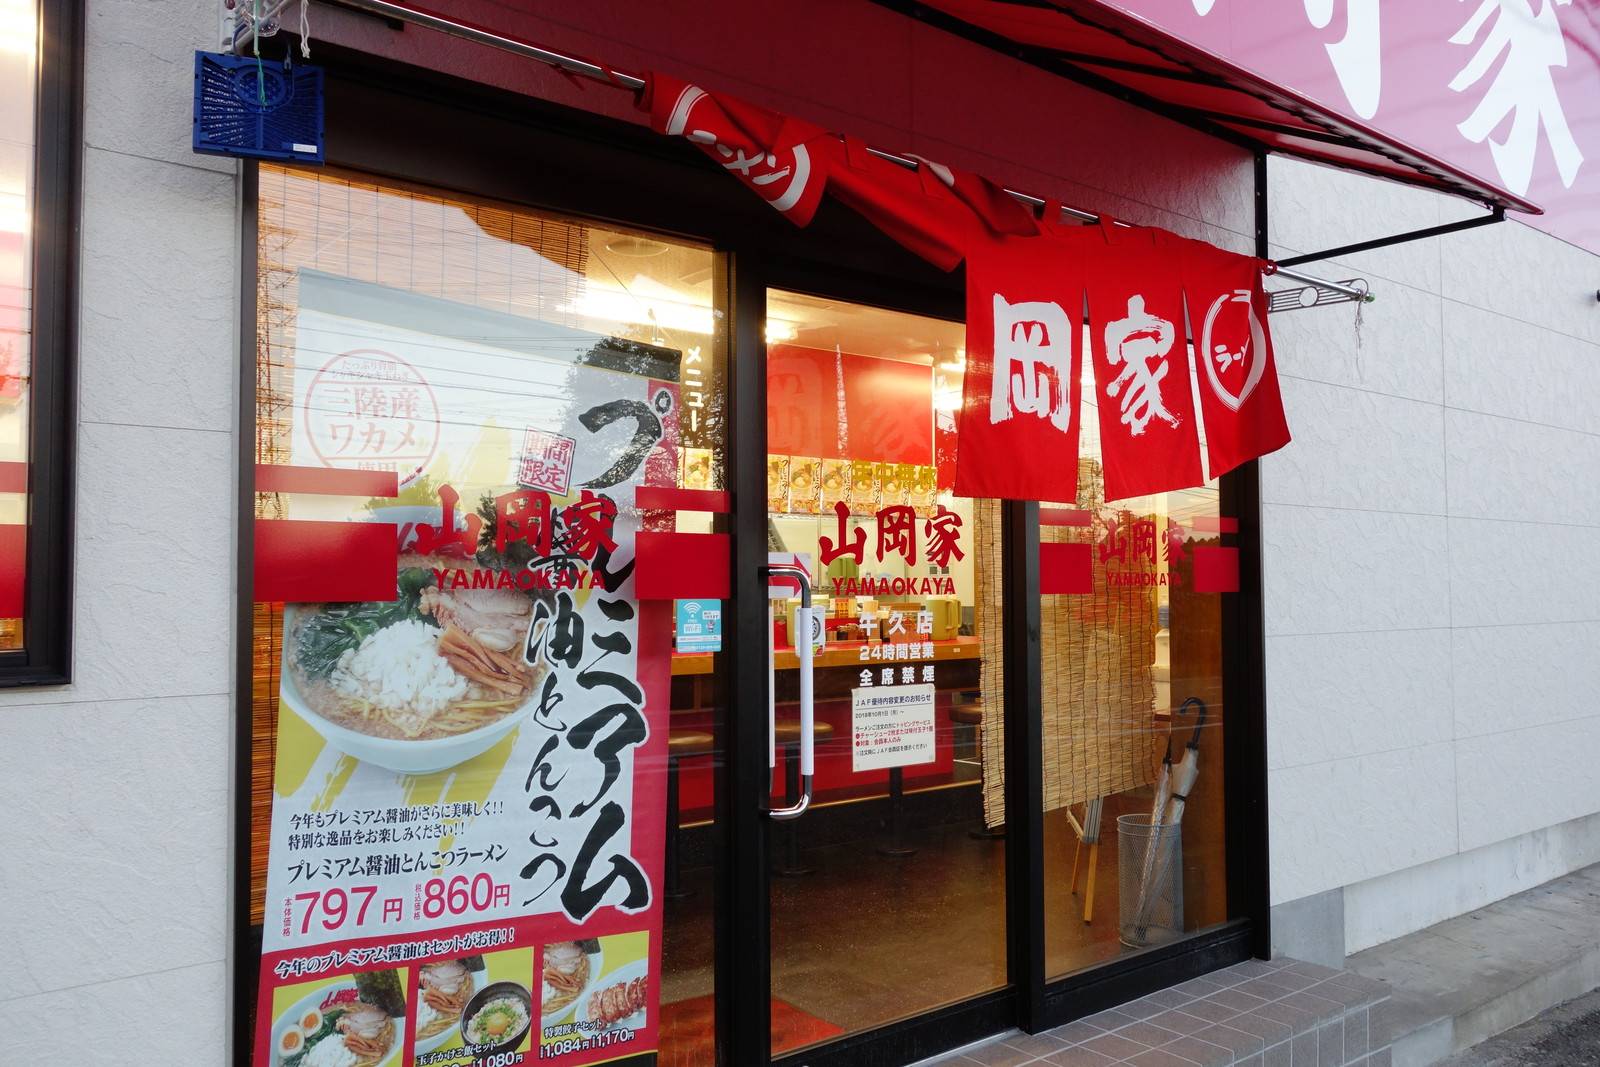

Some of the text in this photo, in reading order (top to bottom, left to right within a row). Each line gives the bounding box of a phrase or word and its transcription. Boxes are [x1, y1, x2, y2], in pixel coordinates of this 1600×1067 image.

[322, 386, 421, 420] 三陸産
[685, 345, 705, 433] メニュー
[328, 421, 416, 454] ワカメ
[524, 458, 566, 492] 限定
[415, 484, 620, 560] 山岡家
[819, 501, 965, 568] 山岡家
[1100, 517, 1186, 568] 山岡家
[433, 567, 606, 591] YAMAOKAYA
[831, 577, 956, 596] YAMAOKAYA
[859, 610, 933, 637] 牛久店
[859, 642, 935, 661] 24時間営業
[859, 665, 935, 687] 全席禁煙
[287, 843, 509, 885] プレミアム醤油とんこつラーメン
[295, 885, 403, 934] 797円
[422, 872, 510, 919] 860円
[545, 1038, 590, 1058] 1,084円
[596, 1028, 635, 1048] 1,170円
